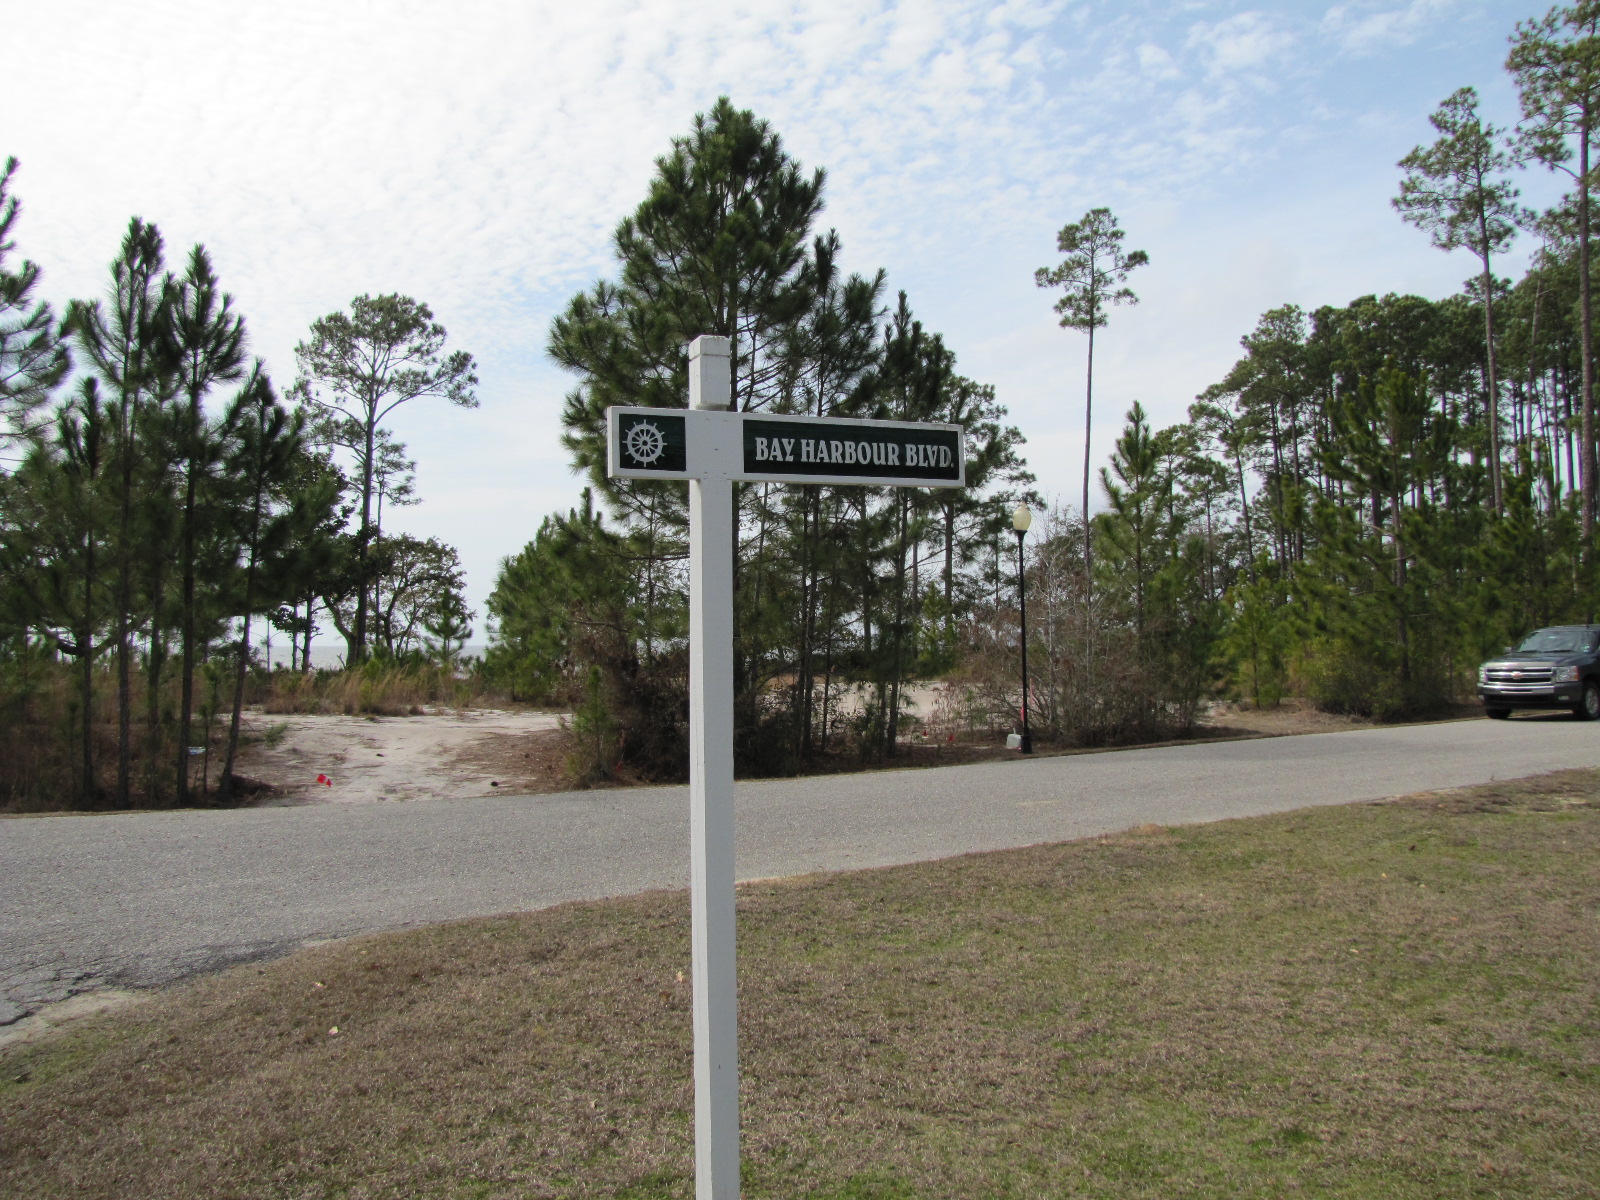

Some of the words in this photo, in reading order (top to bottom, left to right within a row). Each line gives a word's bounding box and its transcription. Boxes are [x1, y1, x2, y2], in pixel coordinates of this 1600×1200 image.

[755, 437, 795, 462] BAY
[800, 439, 900, 466] HARBOUR
[905, 444, 955, 469] BLVD.
